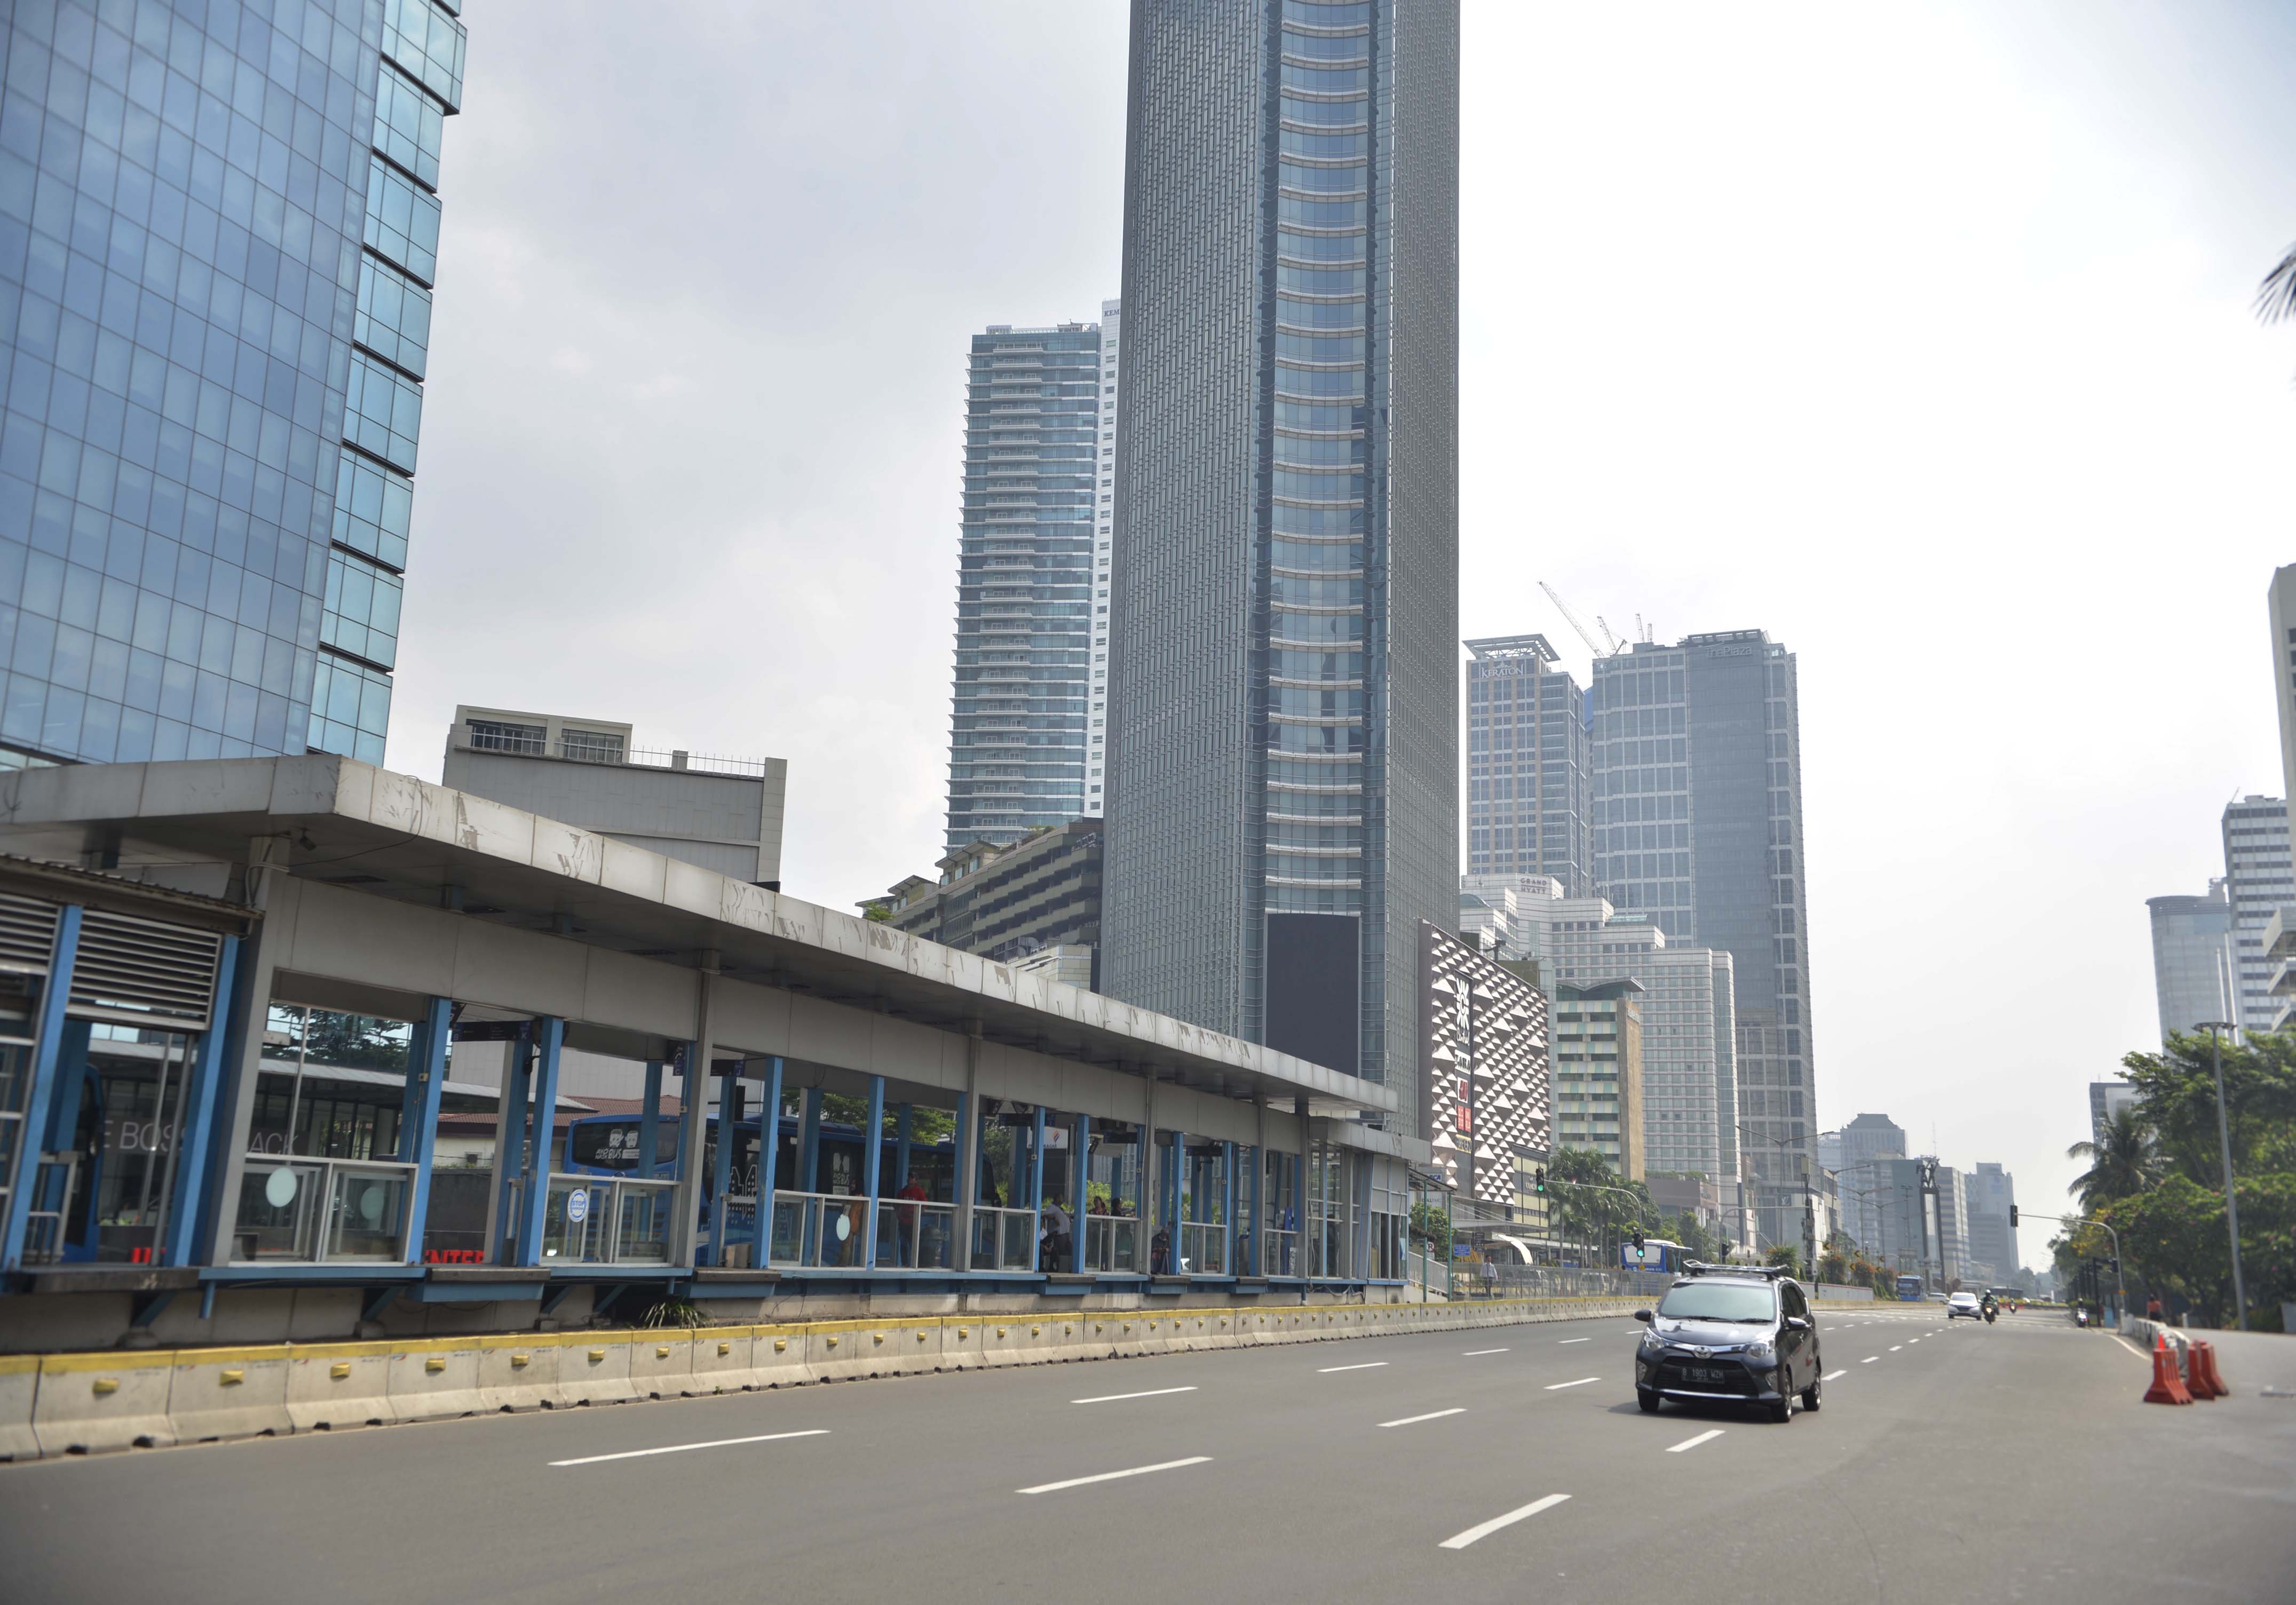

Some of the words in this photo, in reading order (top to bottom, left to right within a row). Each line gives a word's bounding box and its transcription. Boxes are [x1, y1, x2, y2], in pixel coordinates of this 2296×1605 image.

[1482, 663, 1524, 679] KERATON
[1521, 878, 1546, 886] GRAND
[1455, 1054, 1471, 1071] ZARA
[608, 1148, 622, 1159] BUS
[1683, 1368, 1687, 1376] B
